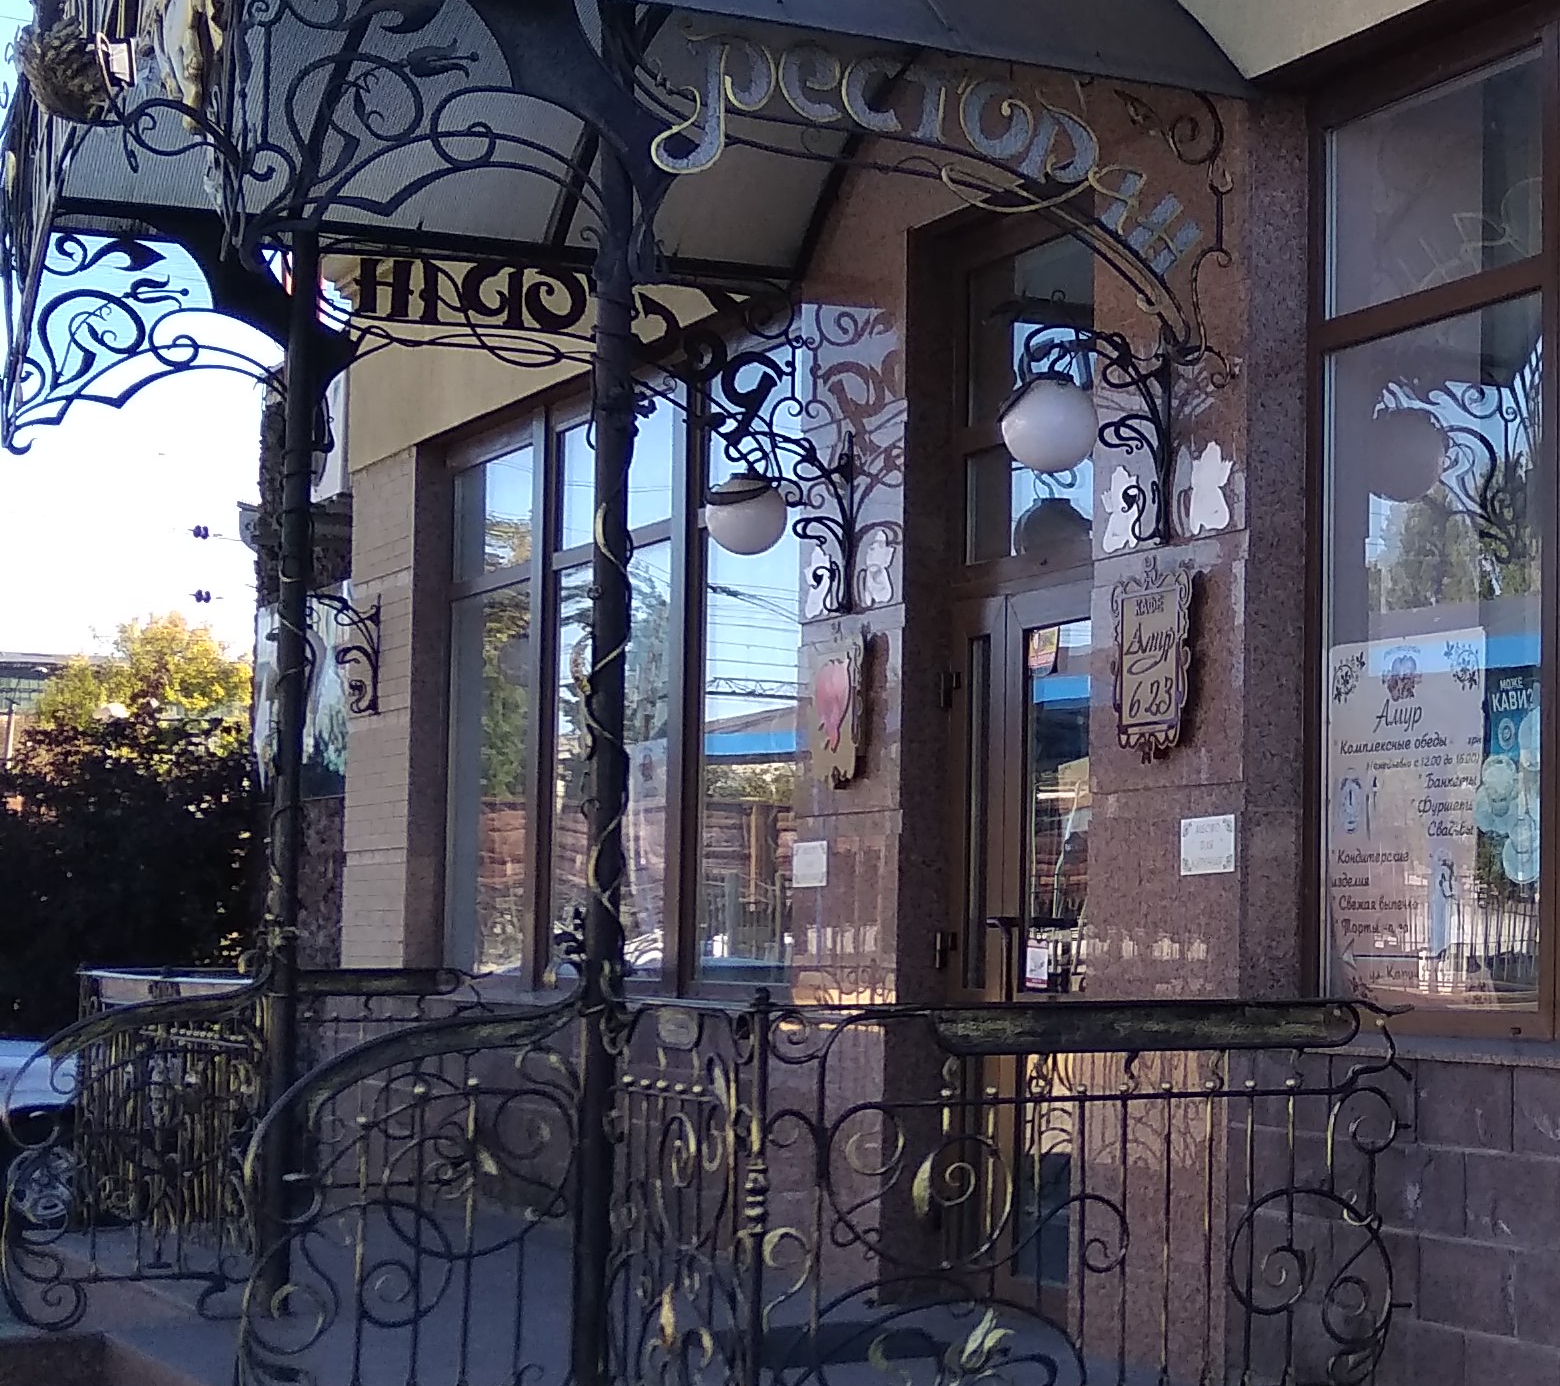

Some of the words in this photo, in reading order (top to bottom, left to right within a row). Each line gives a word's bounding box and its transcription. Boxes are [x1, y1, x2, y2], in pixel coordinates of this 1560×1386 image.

[1500, 677, 1524, 691] МОЖЕ
[1492, 688, 1534, 713] КАВИ?
[1372, 699, 1423, 733] Амур
[1340, 738, 1411, 755] Комплексные
[1414, 735, 1448, 749] обеды
